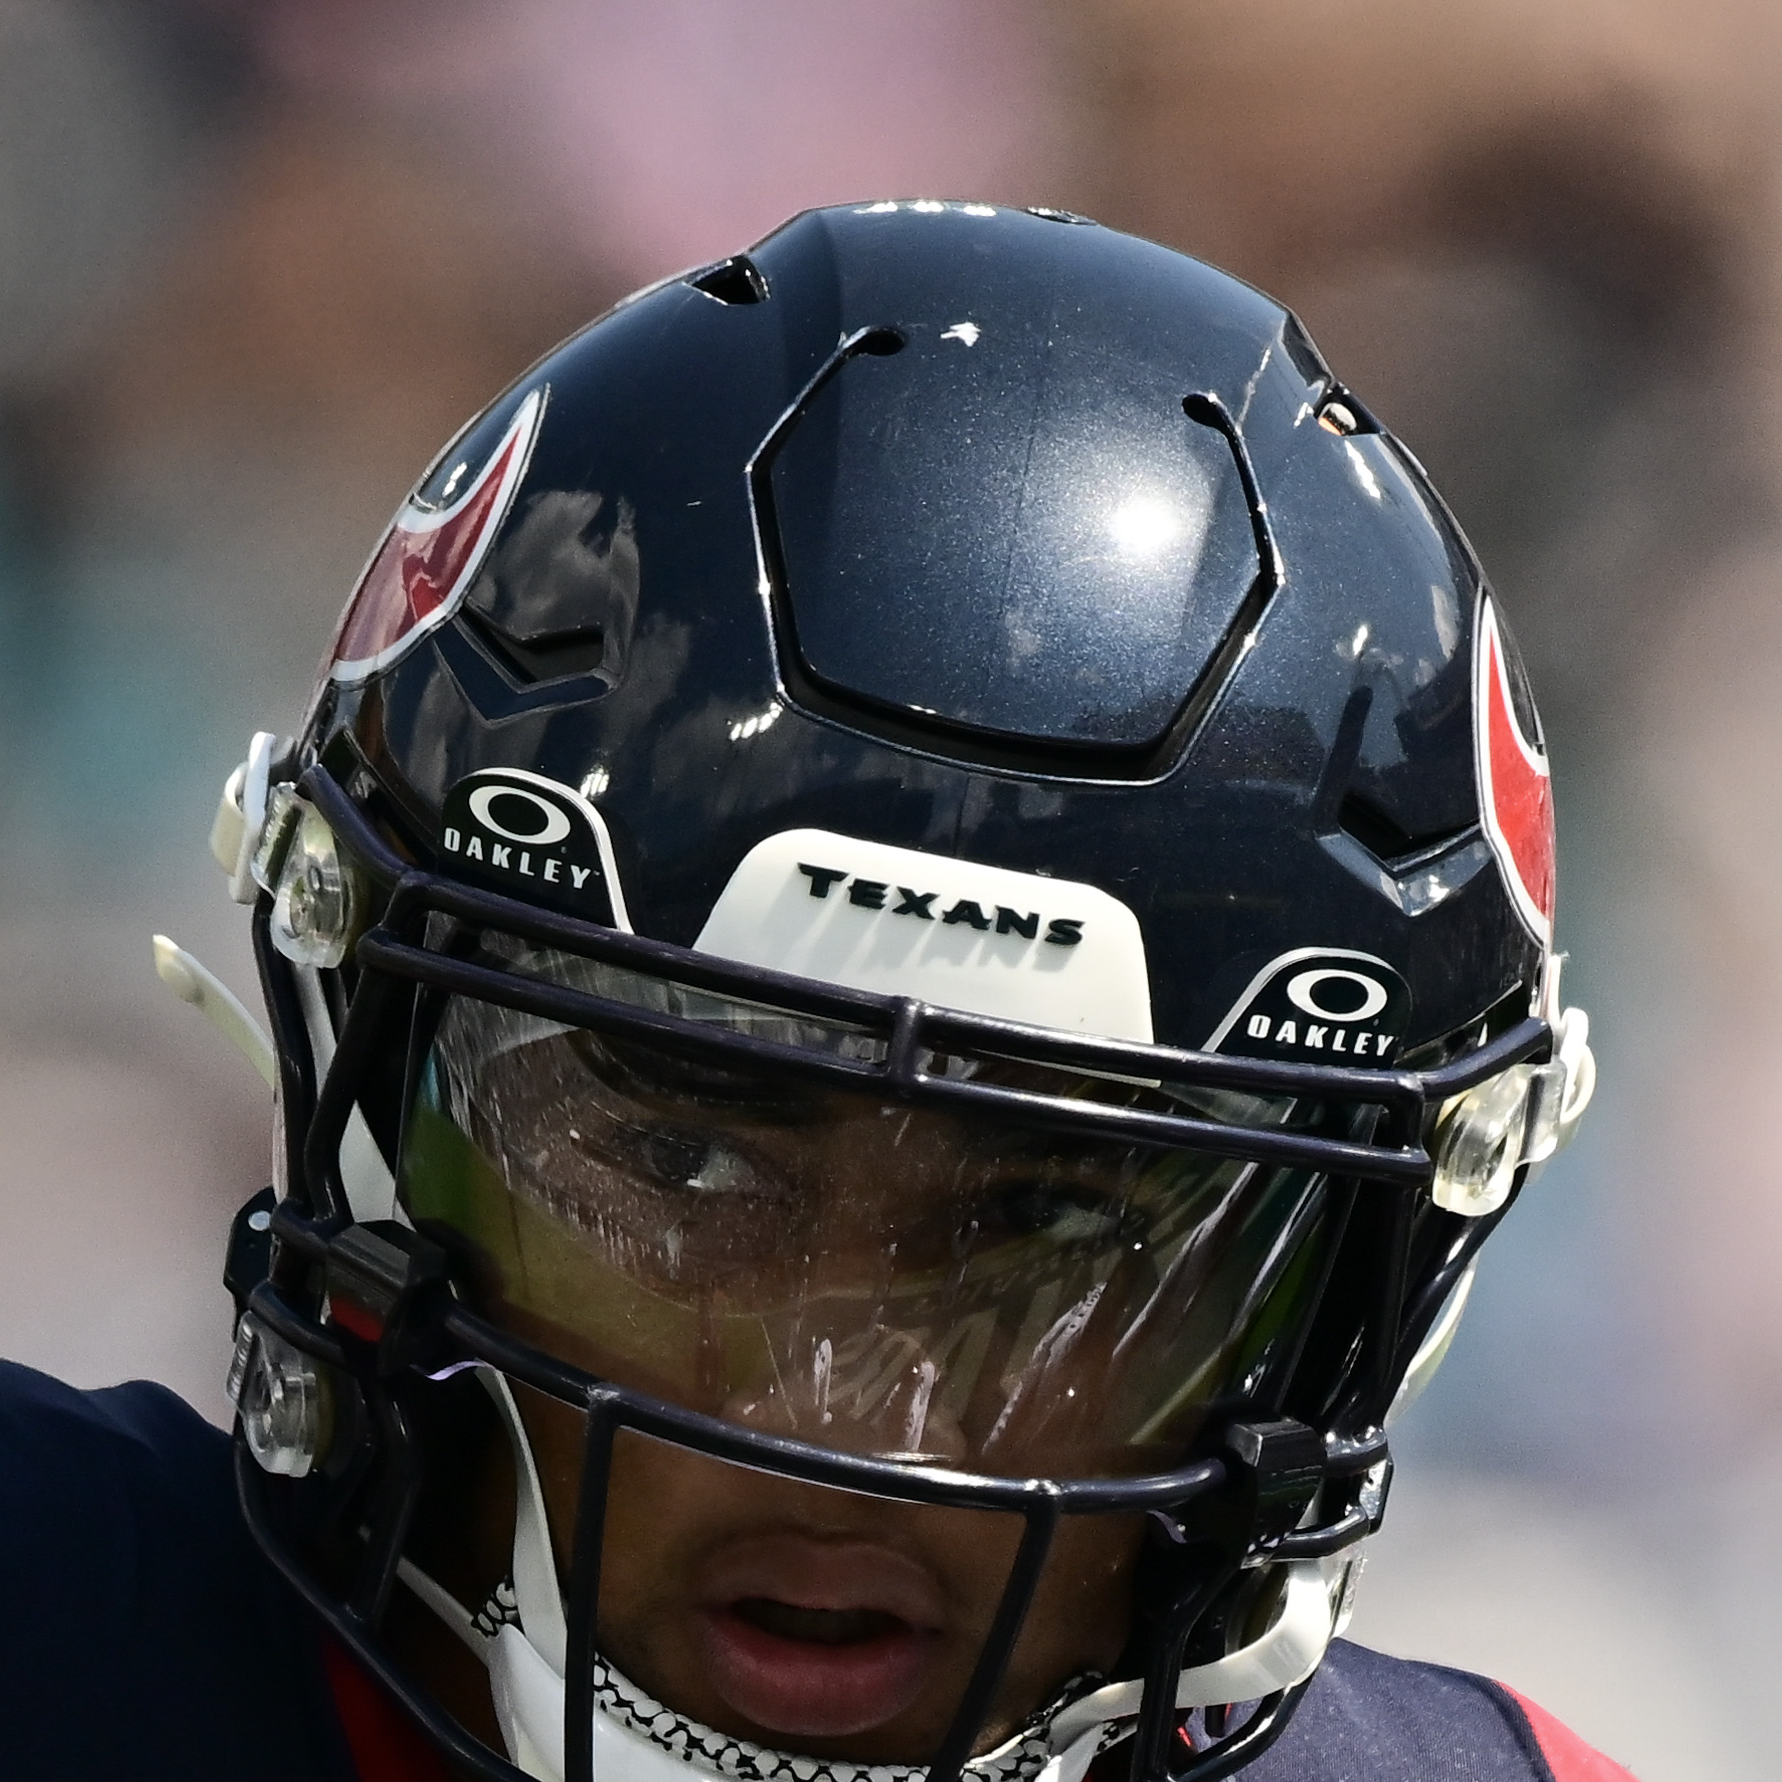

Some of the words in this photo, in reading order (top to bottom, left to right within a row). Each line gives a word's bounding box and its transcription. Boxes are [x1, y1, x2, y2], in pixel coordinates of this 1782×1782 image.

[444, 827, 591, 889] OAKLEY
[796, 862, 1086, 945] TEXANS
[1247, 1014, 1394, 1057] OAKLEY
